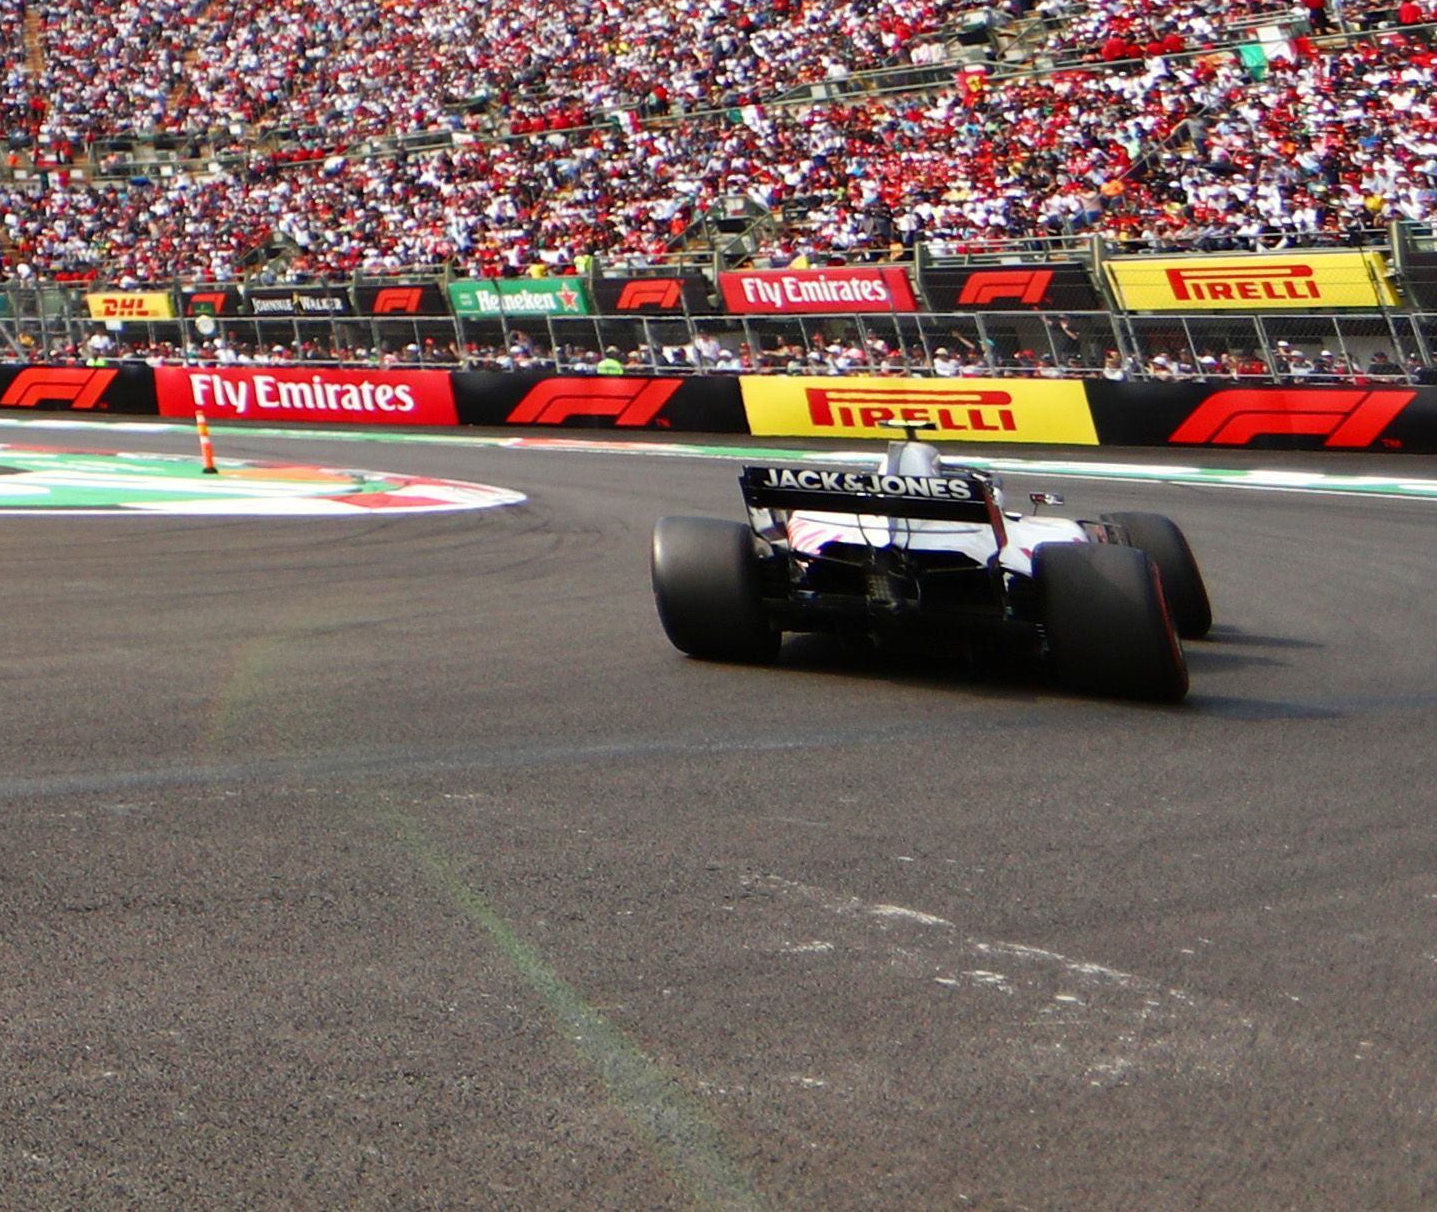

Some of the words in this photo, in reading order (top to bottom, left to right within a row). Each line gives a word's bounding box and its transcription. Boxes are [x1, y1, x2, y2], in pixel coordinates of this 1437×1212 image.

[475, 289, 556, 313] Heneken
[741, 277, 782, 308] Fly
[782, 274, 888, 302] Emirates
[1166, 264, 1322, 302] PIRELLI
[102, 298, 149, 317] DHL
[189, 373, 247, 413] Fly
[252, 375, 415, 412] Emirates
[805, 388, 1018, 431] PIRELLI
